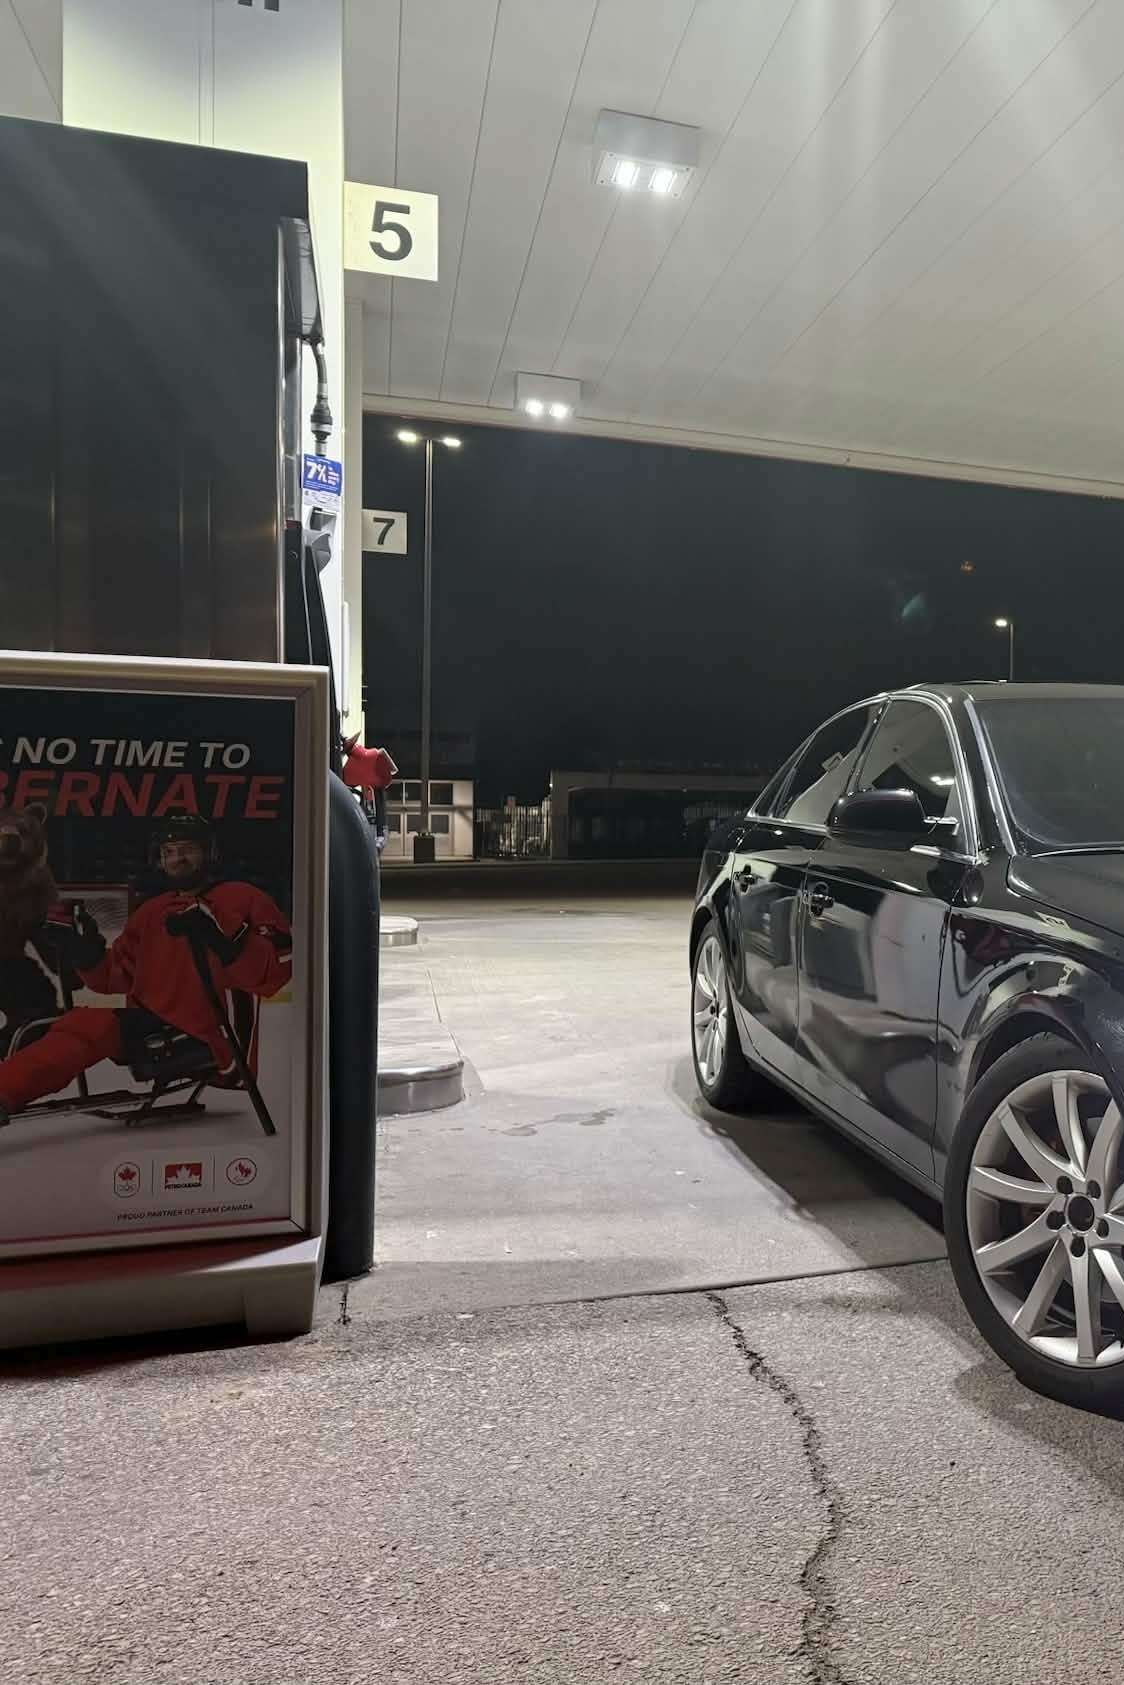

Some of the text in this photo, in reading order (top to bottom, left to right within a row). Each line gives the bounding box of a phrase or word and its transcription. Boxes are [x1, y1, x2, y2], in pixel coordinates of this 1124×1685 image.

[368, 201, 413, 261] 5
[373, 517, 395, 545] 7
[12, 737, 251, 769] NO TIME TO
[0, 770, 285, 819] ERNATE
